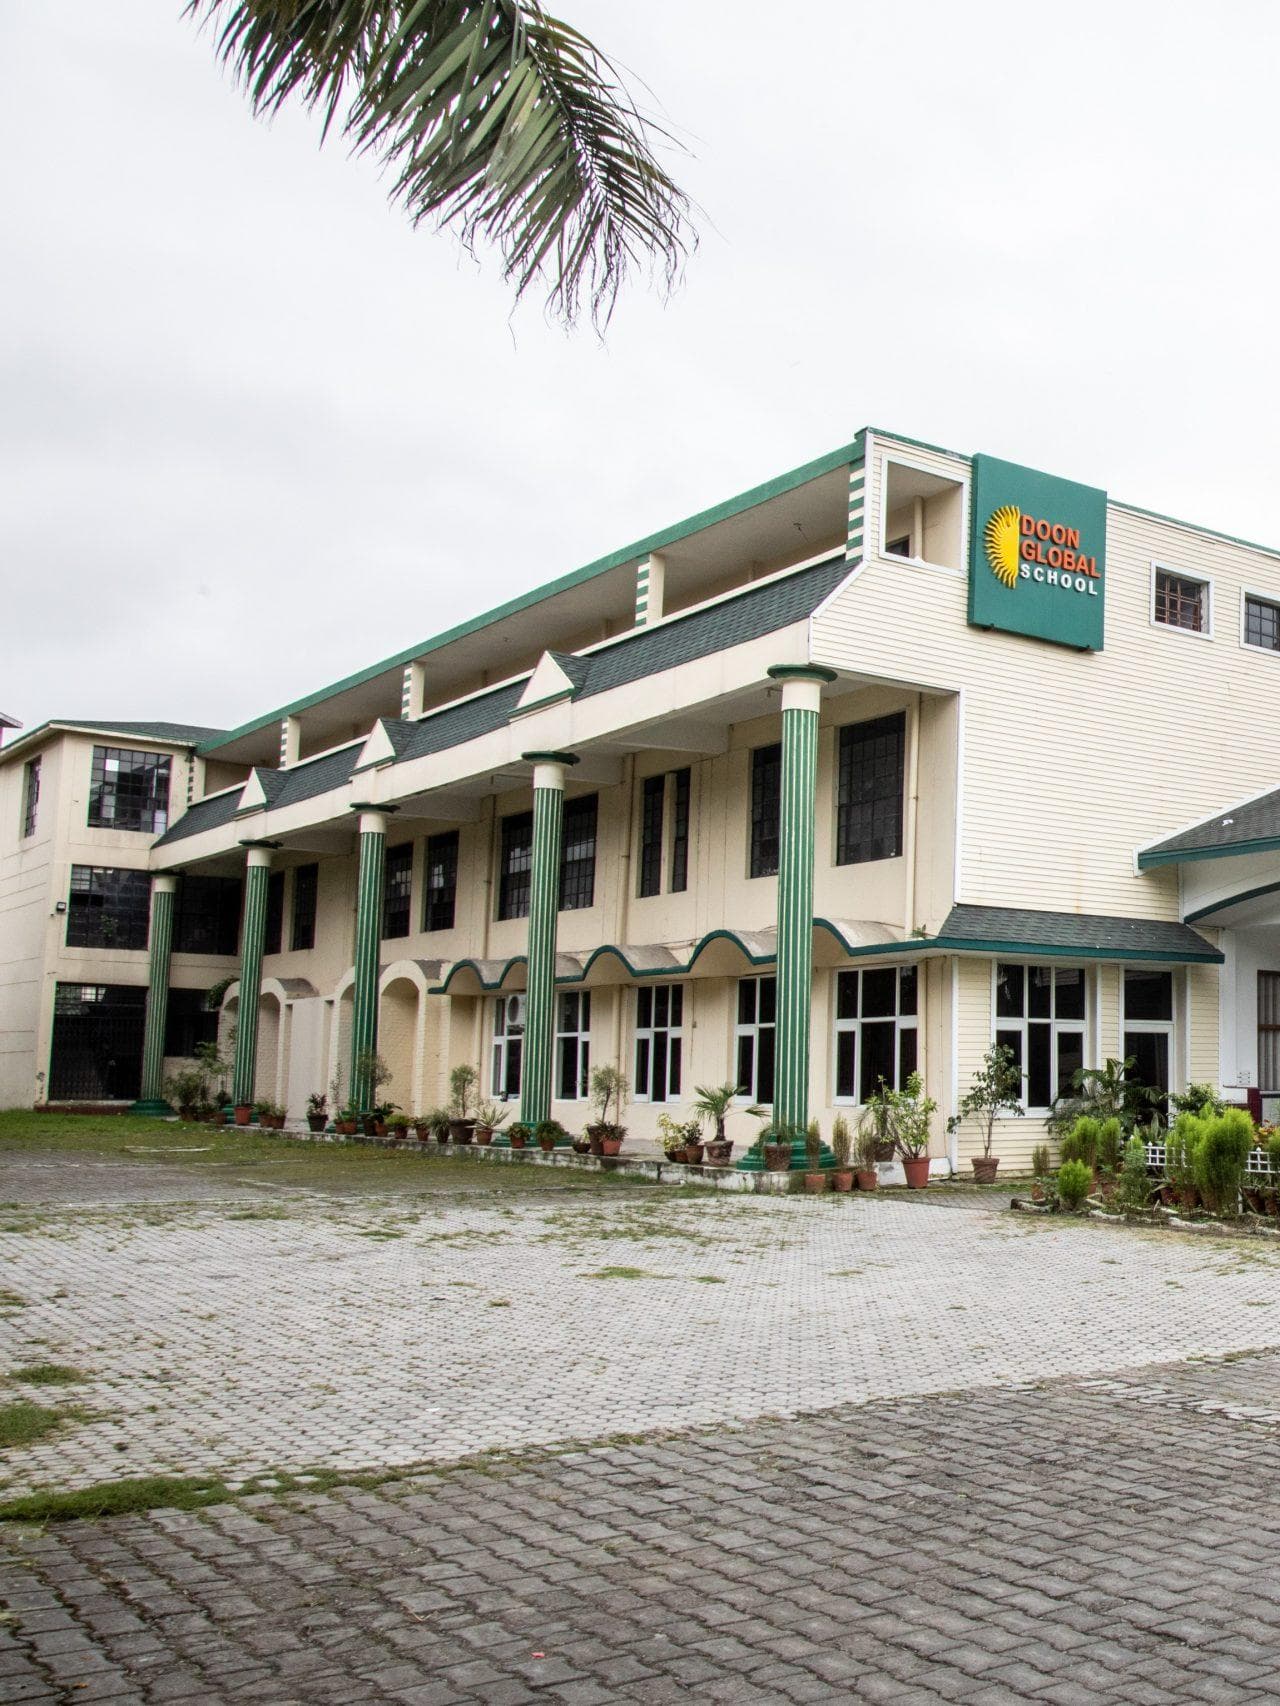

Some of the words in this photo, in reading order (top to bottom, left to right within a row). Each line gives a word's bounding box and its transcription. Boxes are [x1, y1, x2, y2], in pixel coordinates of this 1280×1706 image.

[1021, 515, 1080, 549] DOON
[1021, 540, 1101, 579] GLOBAL
[1020, 564, 1098, 595] SCHOOL
